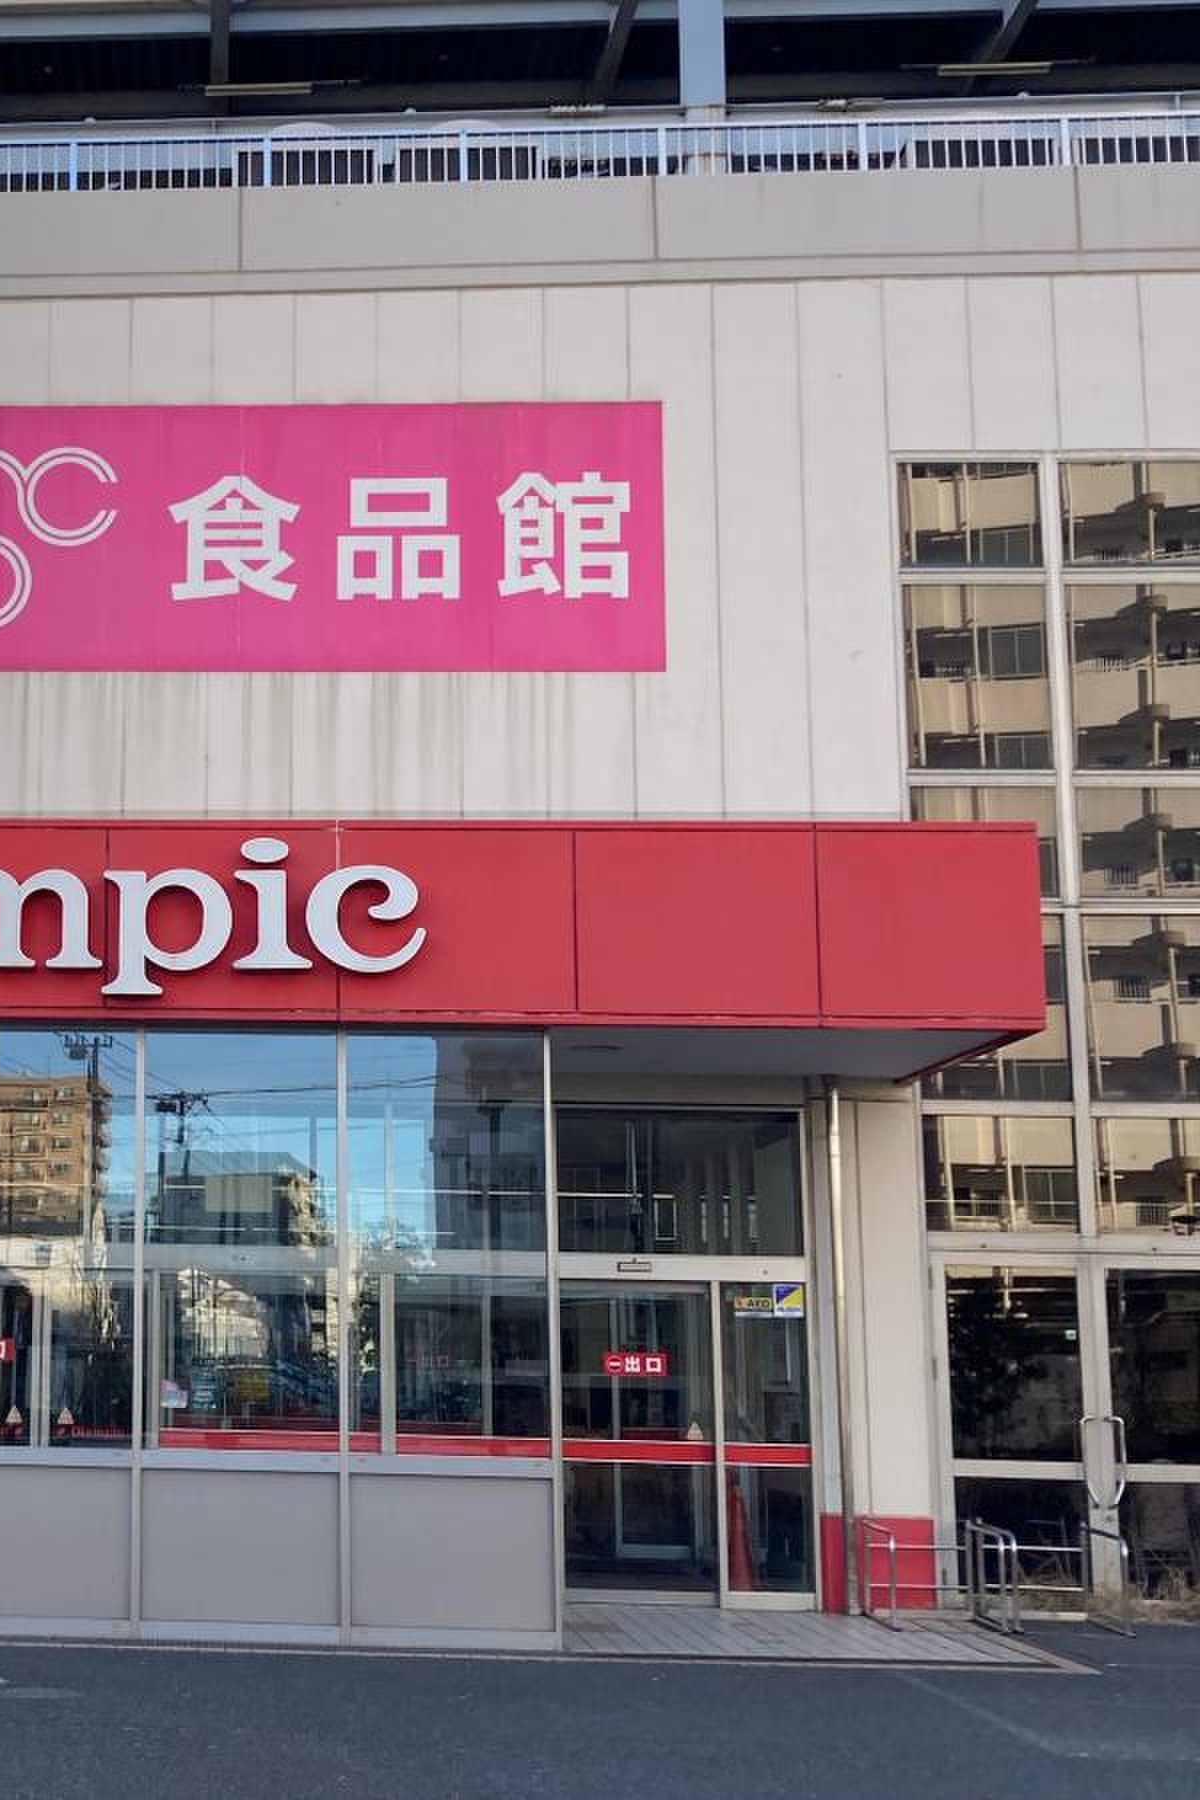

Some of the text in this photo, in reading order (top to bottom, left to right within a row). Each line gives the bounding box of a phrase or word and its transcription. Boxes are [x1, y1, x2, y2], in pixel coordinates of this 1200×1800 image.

[168, 471, 631, 602] 食品館
[623, 1355, 662, 1373] 出口
